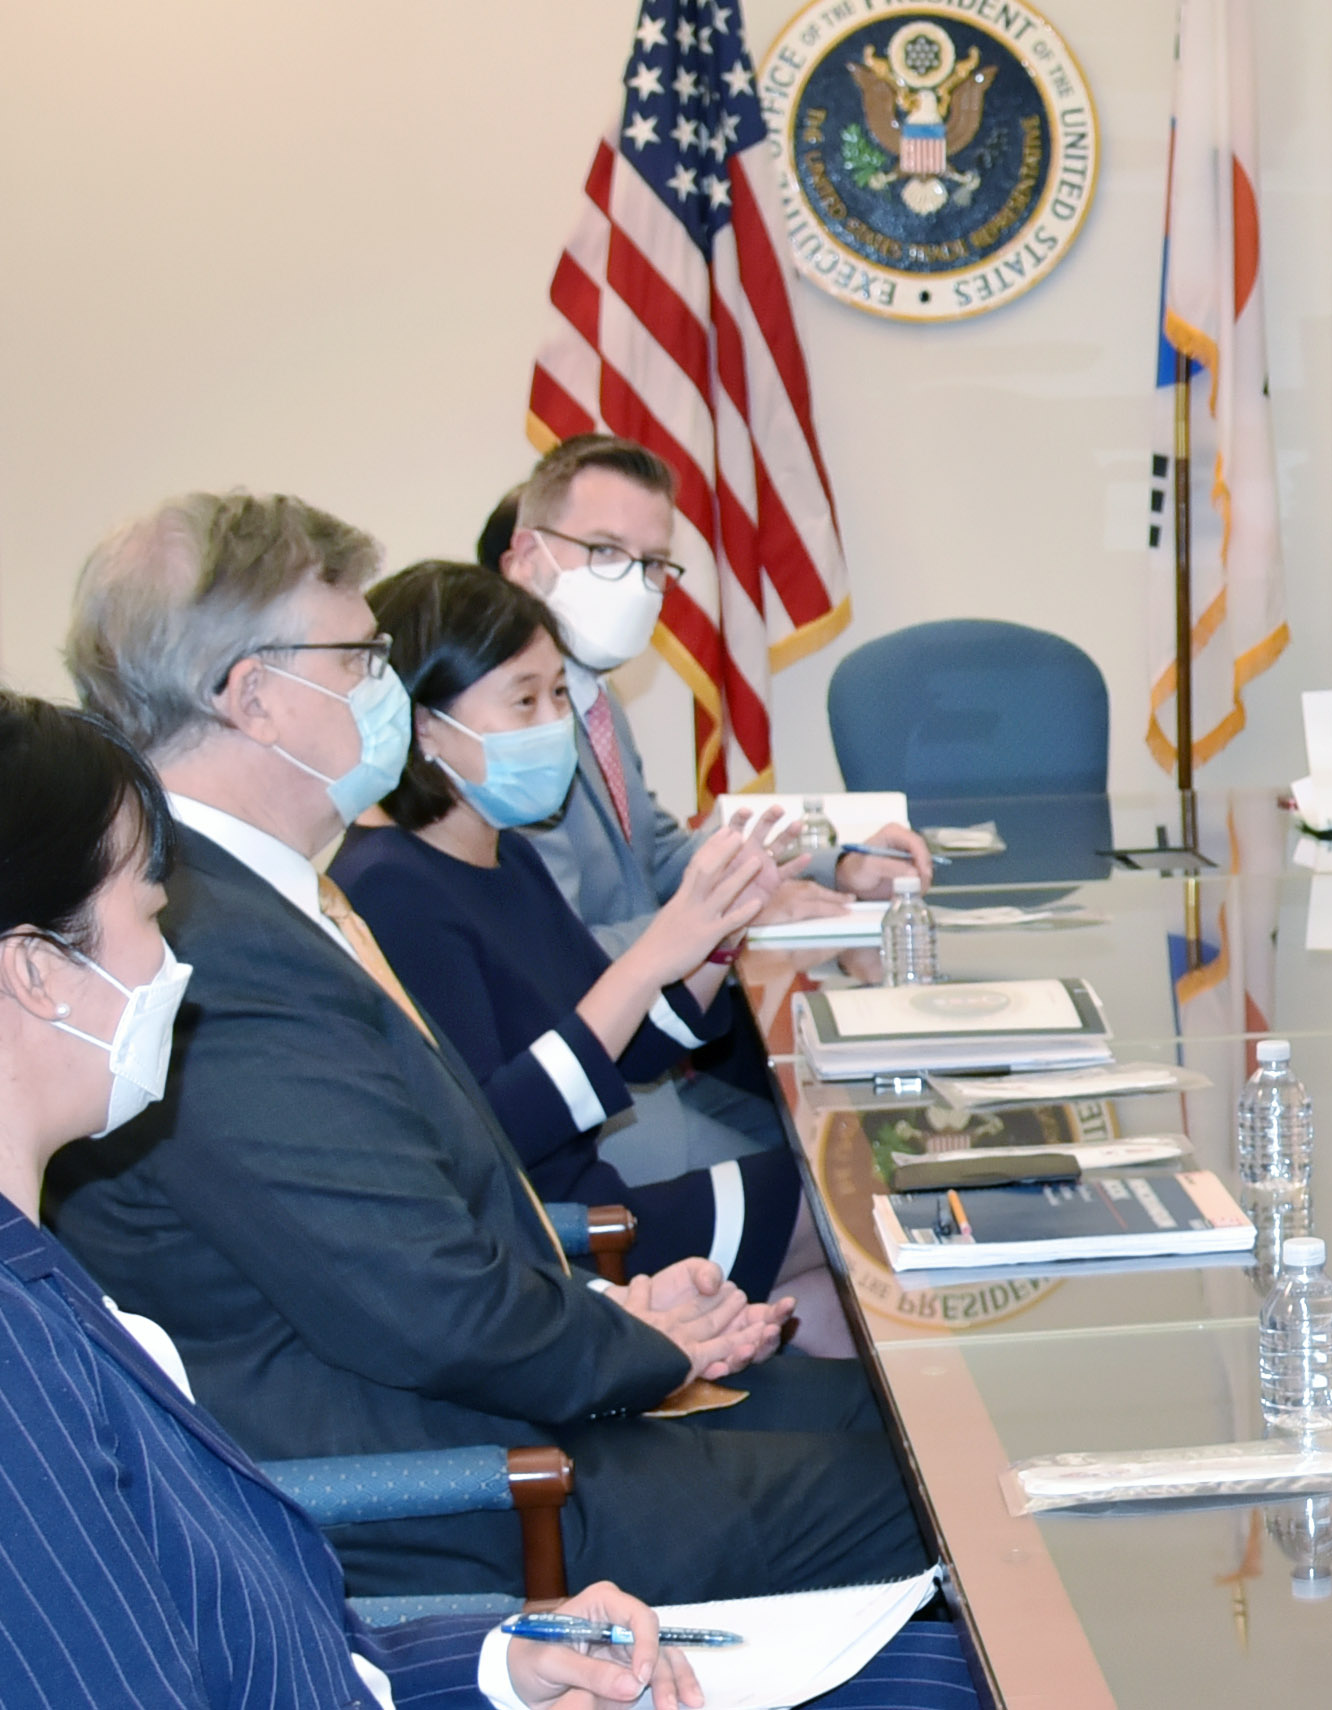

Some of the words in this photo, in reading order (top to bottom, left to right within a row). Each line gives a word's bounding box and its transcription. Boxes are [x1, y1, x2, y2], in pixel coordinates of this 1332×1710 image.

[821, 1, 855, 28] THE
[801, 24, 820, 46] OF
[1033, 41, 1055, 60] OF
[1050, 65, 1075, 98] THE
[1051, 107, 1088, 221] UNITED
[954, 225, 1058, 306] STATES
